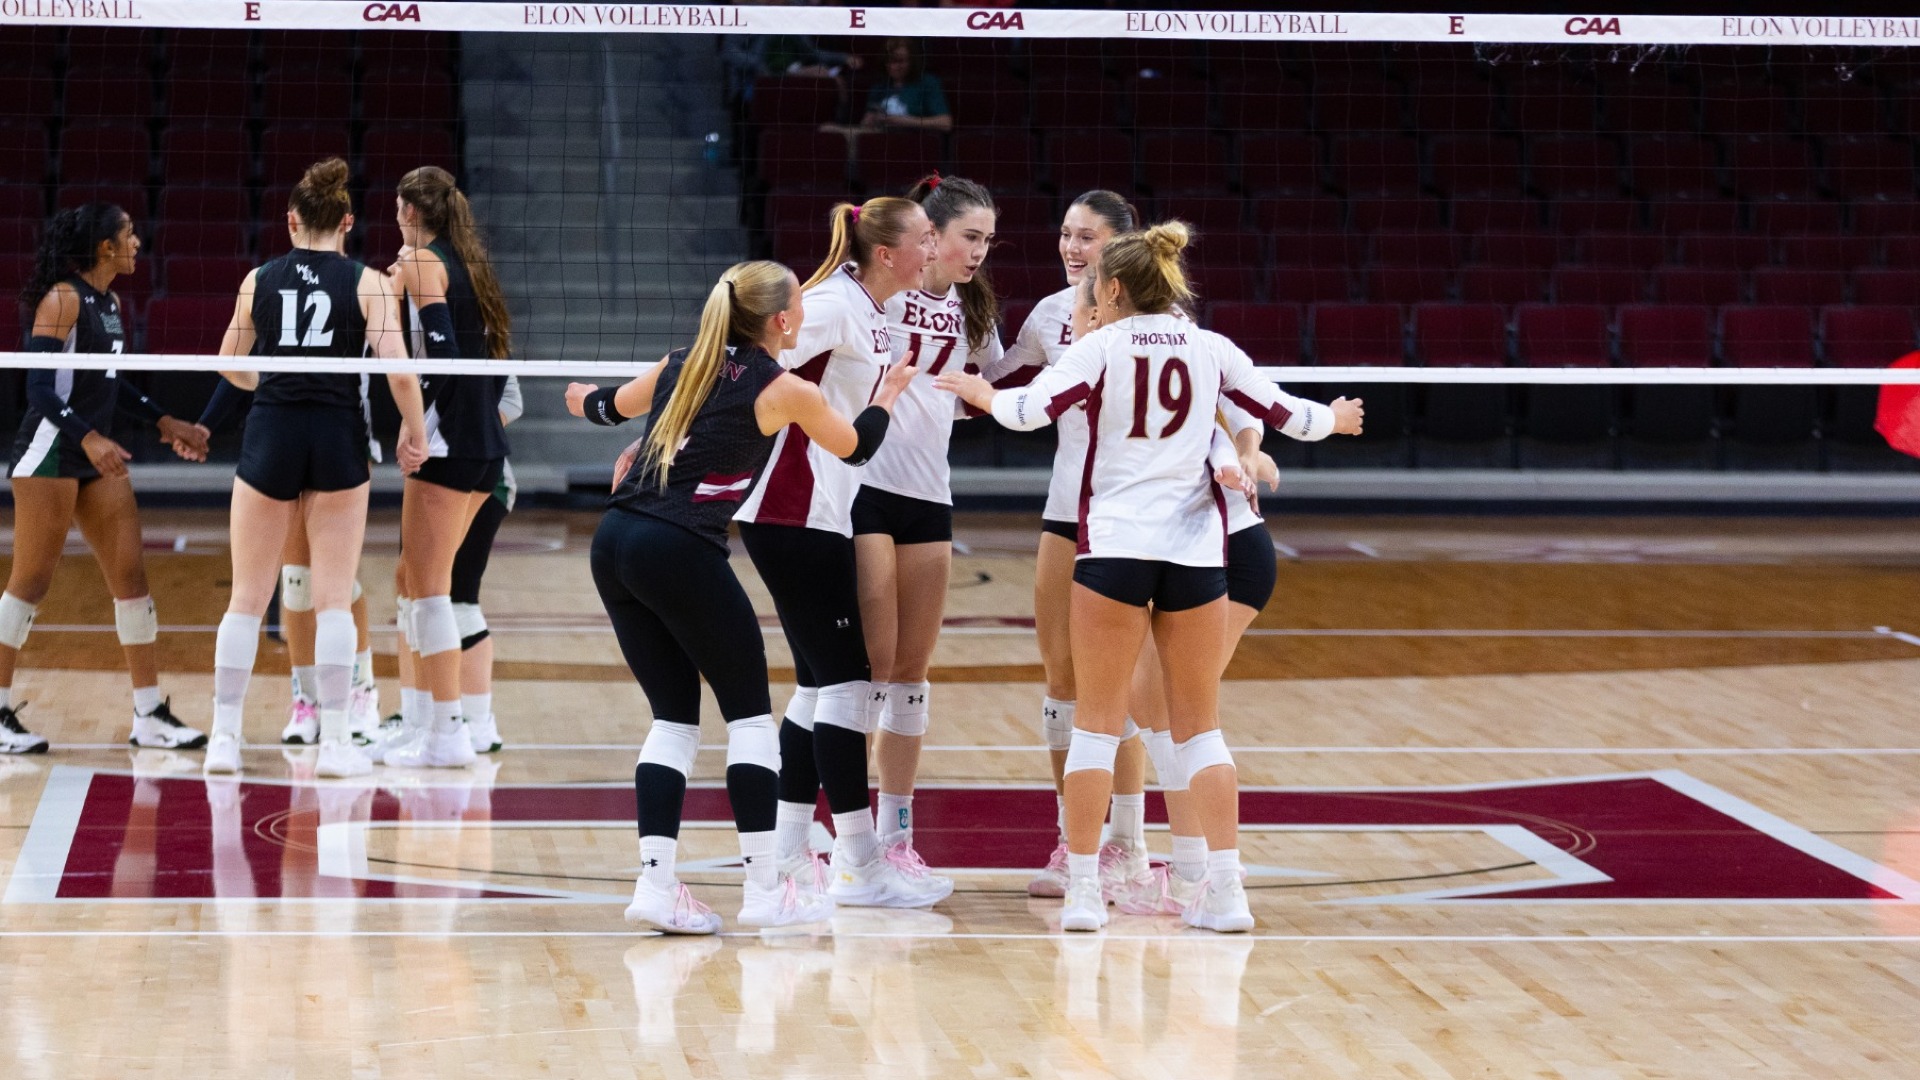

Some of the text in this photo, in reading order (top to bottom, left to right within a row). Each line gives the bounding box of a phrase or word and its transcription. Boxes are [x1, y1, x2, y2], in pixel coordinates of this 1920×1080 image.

[244, 2, 261, 21] E
[362, 2, 421, 22] CAA
[524, 5, 748, 27] ELON VOLLEYBALL
[849, 9, 866, 29] E
[966, 11, 1025, 31] CAA
[1126, 12, 1348, 34] ELON VOLLEYBALL
[1447, 15, 1465, 35] E
[1564, 17, 1622, 36] CAA
[1722, 17, 1783, 37] ELON
[278, 289, 335, 347] 12
[901, 301, 962, 335] ELON
[905, 332, 958, 376] 17
[1126, 355, 1193, 440] 19
